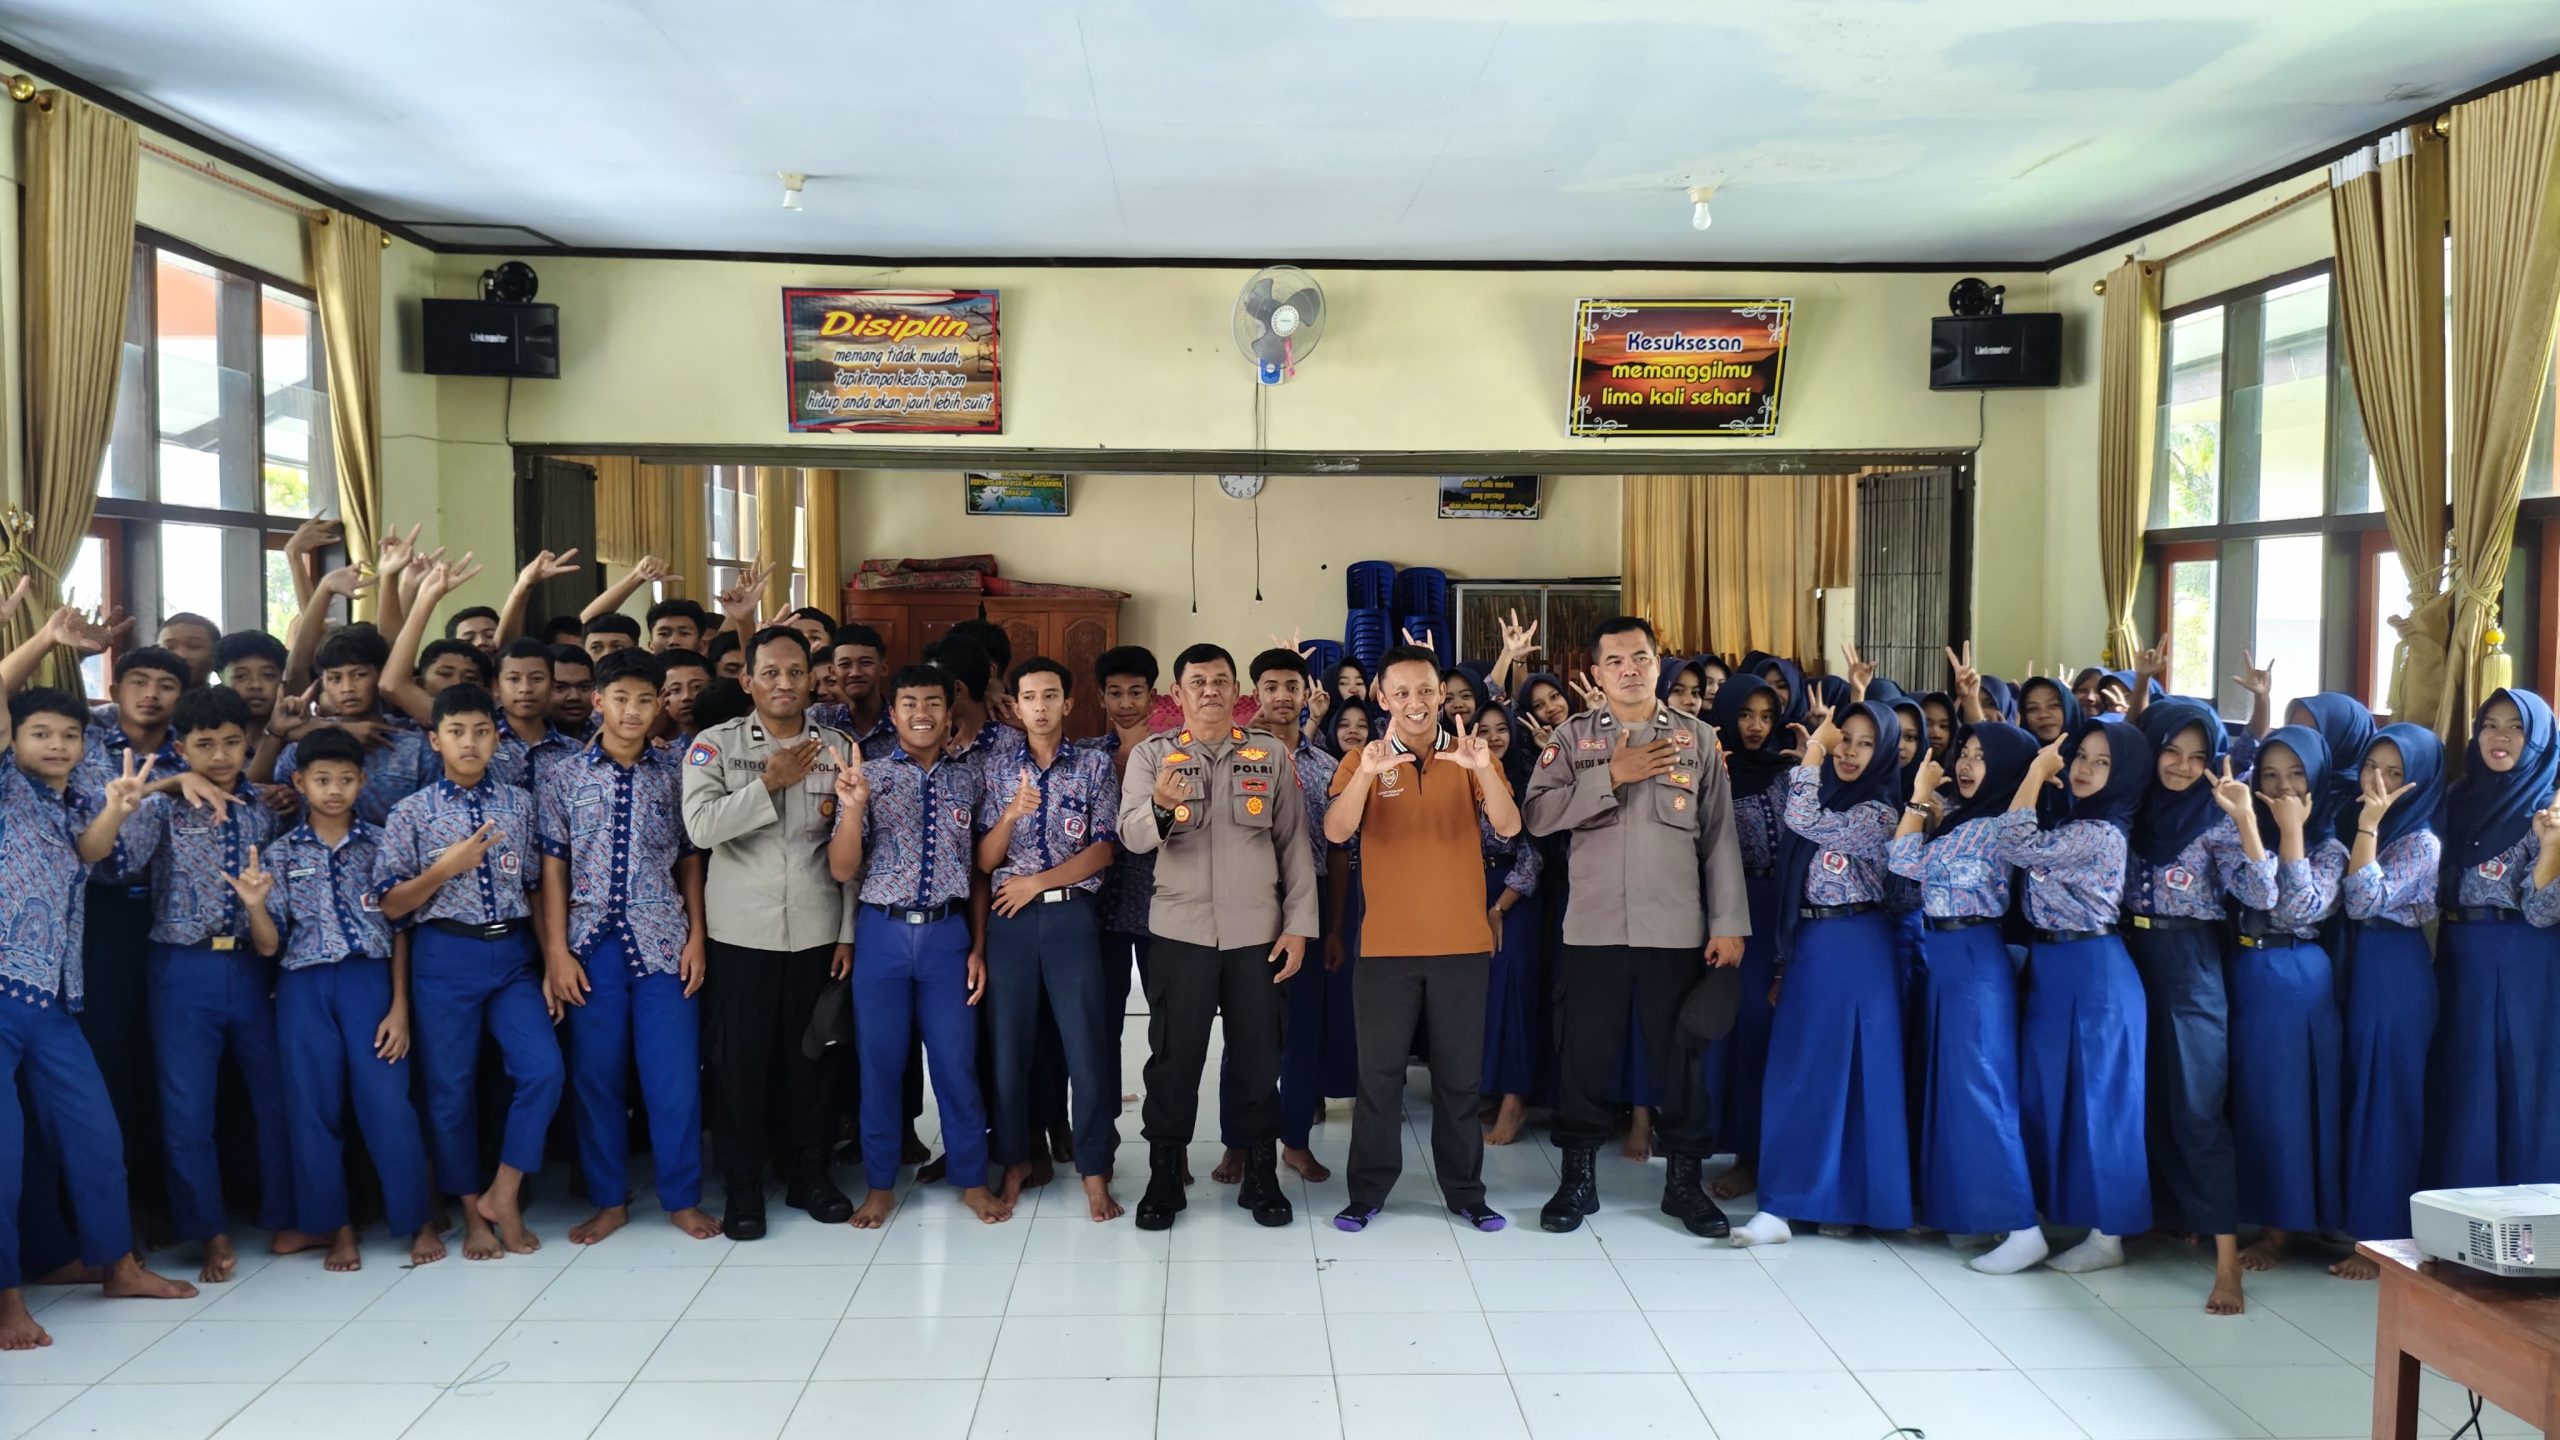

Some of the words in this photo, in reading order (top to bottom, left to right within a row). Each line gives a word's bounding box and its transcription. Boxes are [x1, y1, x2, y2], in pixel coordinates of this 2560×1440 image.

[819, 310, 969, 342] Disiplin
[1626, 332, 1743, 352] Kesuksesan
[834, 349, 883, 366] memang
[887, 347, 916, 363] tidak
[919, 346, 961, 365] mudah,
[835, 370, 860, 391] tapi
[860, 370, 895, 391] tanpa
[895, 370, 967, 391] kedisiplinan
[1611, 361, 1752, 383] memanggilmu
[806, 391, 839, 413] hidup
[842, 393, 871, 410] anda
[874, 392, 900, 409] akan
[902, 393, 931, 413] jauh
[933, 392, 961, 410] lebih
[963, 393, 993, 410] sulit
[1602, 387, 1643, 405] lima
[1649, 387, 1686, 405] kali
[1690, 387, 1751, 405] sehari
[811, 763, 842, 773] POLR
[1233, 764, 1272, 774] POLRI
[1574, 759, 1594, 769] DEDI
[1679, 758, 1698, 769] LRI
